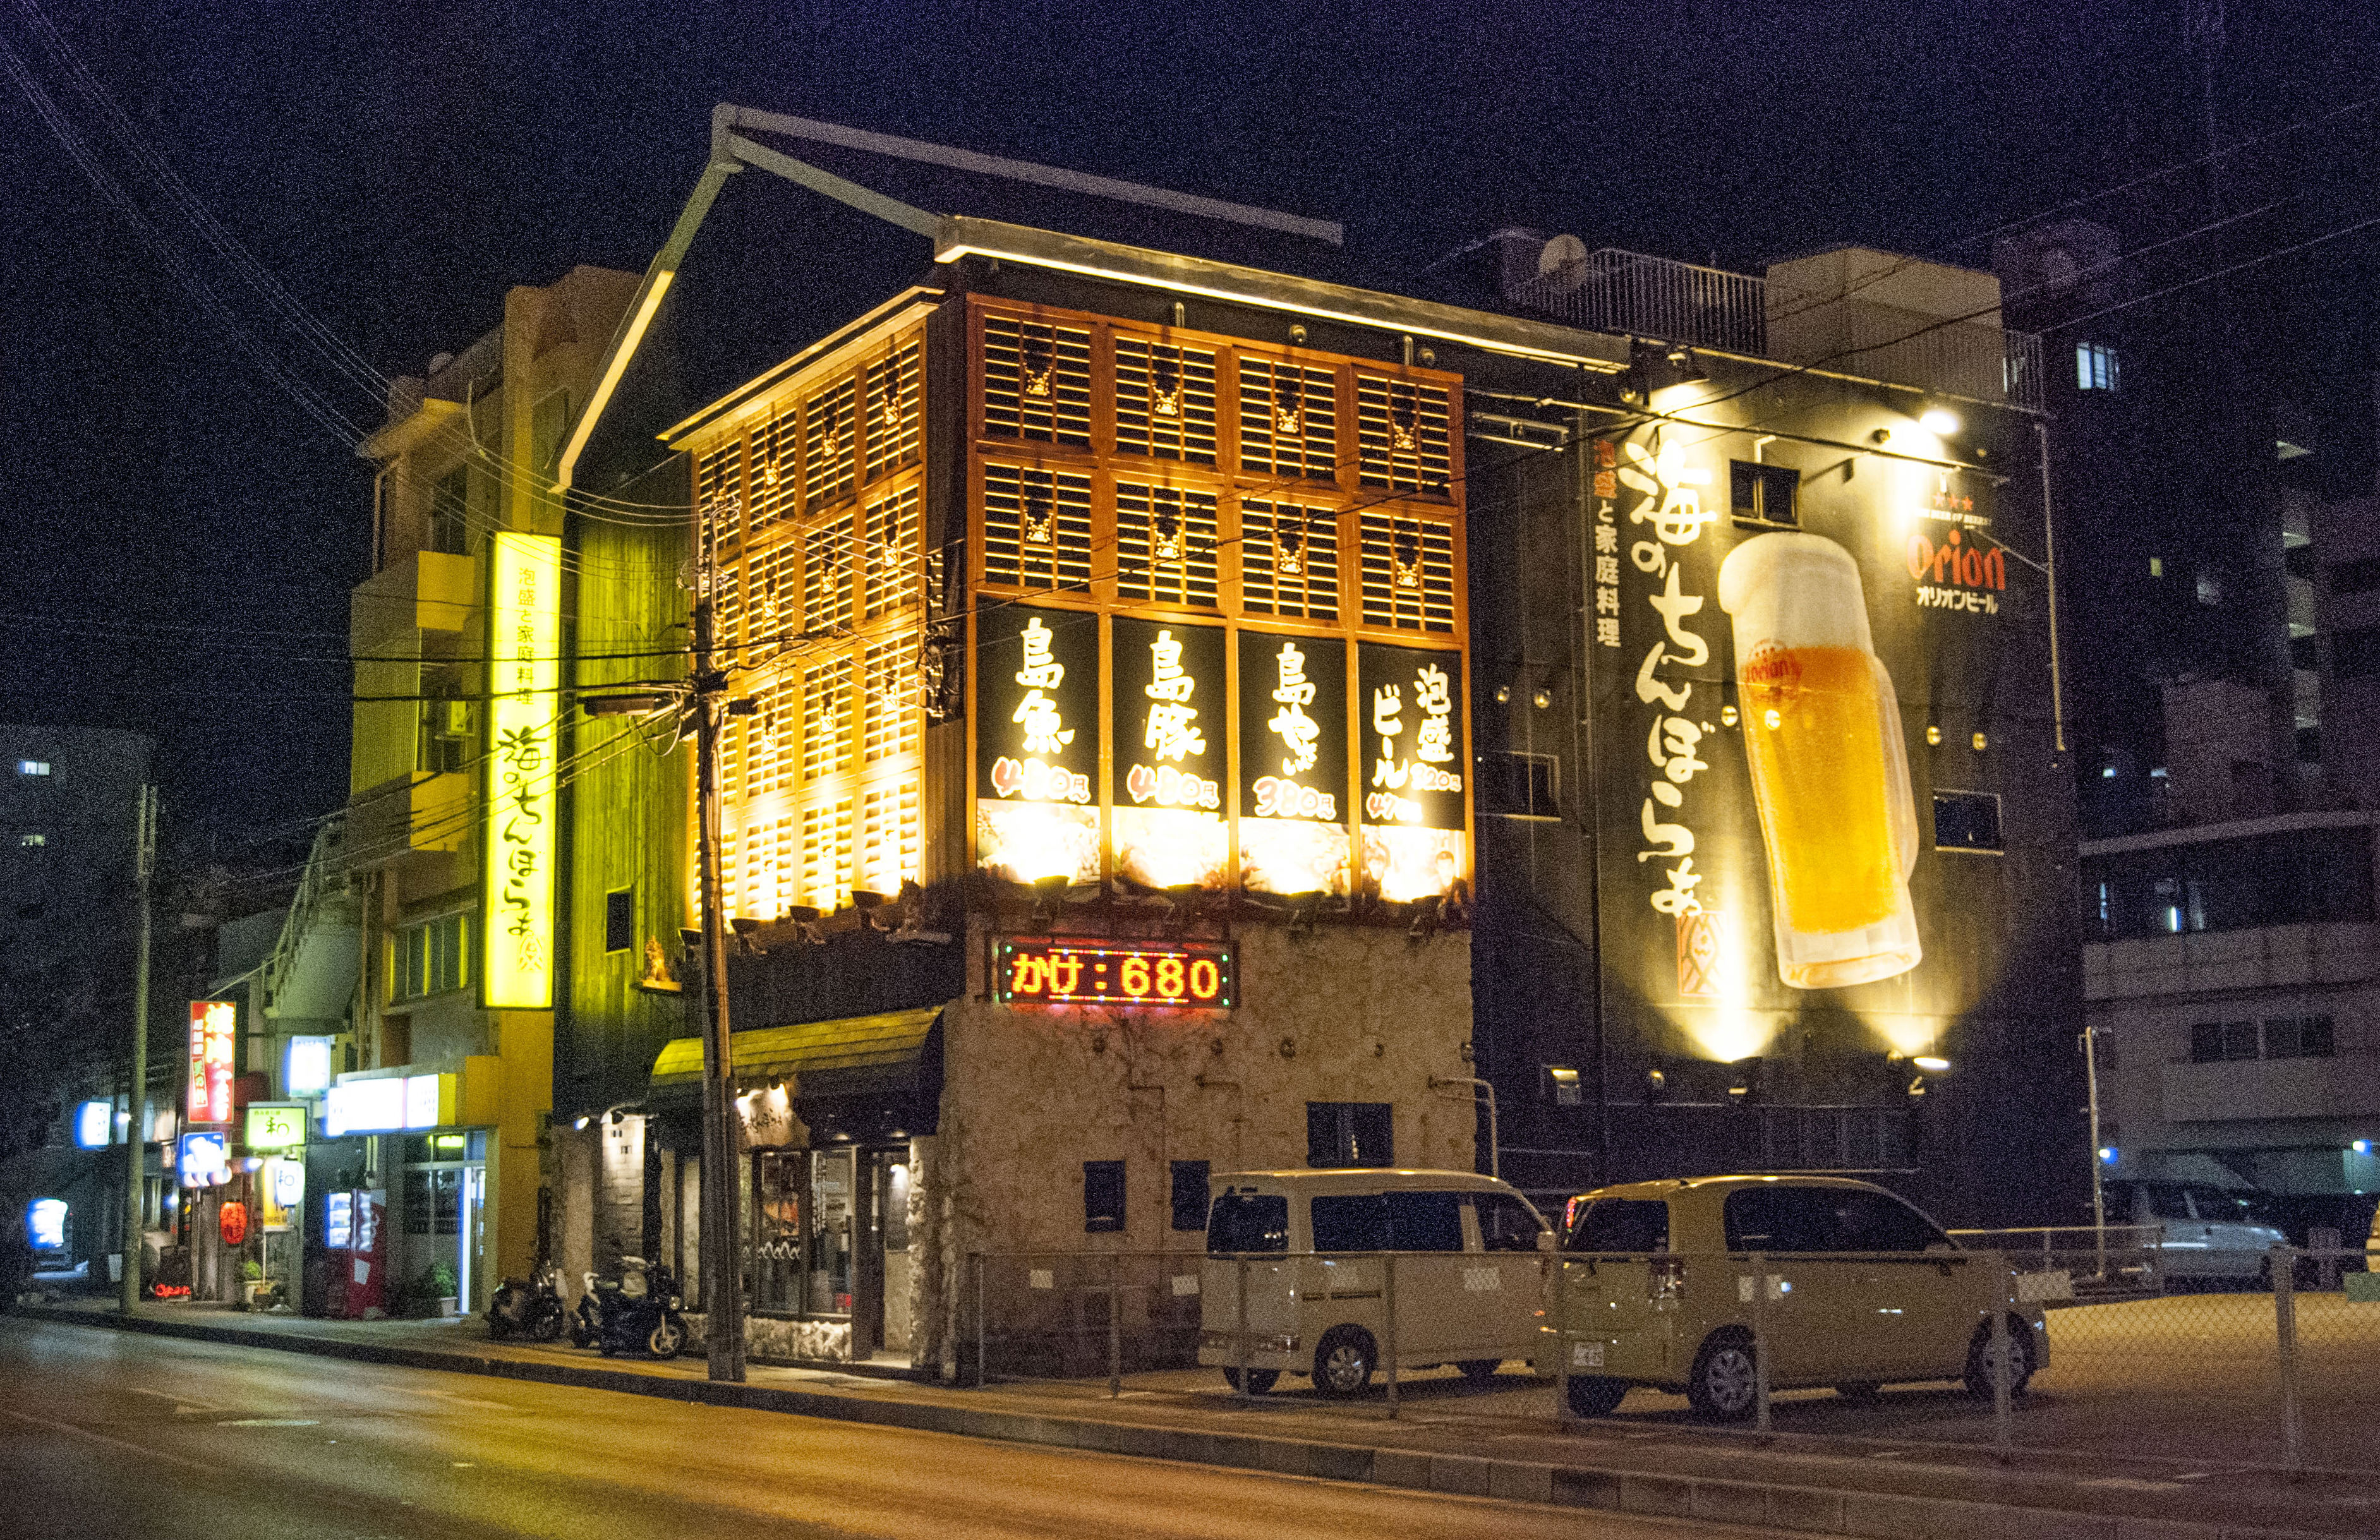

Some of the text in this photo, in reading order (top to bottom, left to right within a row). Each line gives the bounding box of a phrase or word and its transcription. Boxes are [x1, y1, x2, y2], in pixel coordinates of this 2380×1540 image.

[1593, 438, 1621, 647] 泡盛と家庭料理
[1907, 529, 2005, 591] Orion
[516, 567, 536, 706] 泡盛と家庭料理
[1916, 586, 1999, 615] オリオンビール
[1012, 617, 1075, 754] 島魚
[1144, 630, 1207, 762] 島豚
[1372, 684, 1409, 789] ビール
[1413, 663, 1454, 762] 泡盛
[1366, 791, 1422, 822] 47
[265, 1116, 289, 1137] 和
